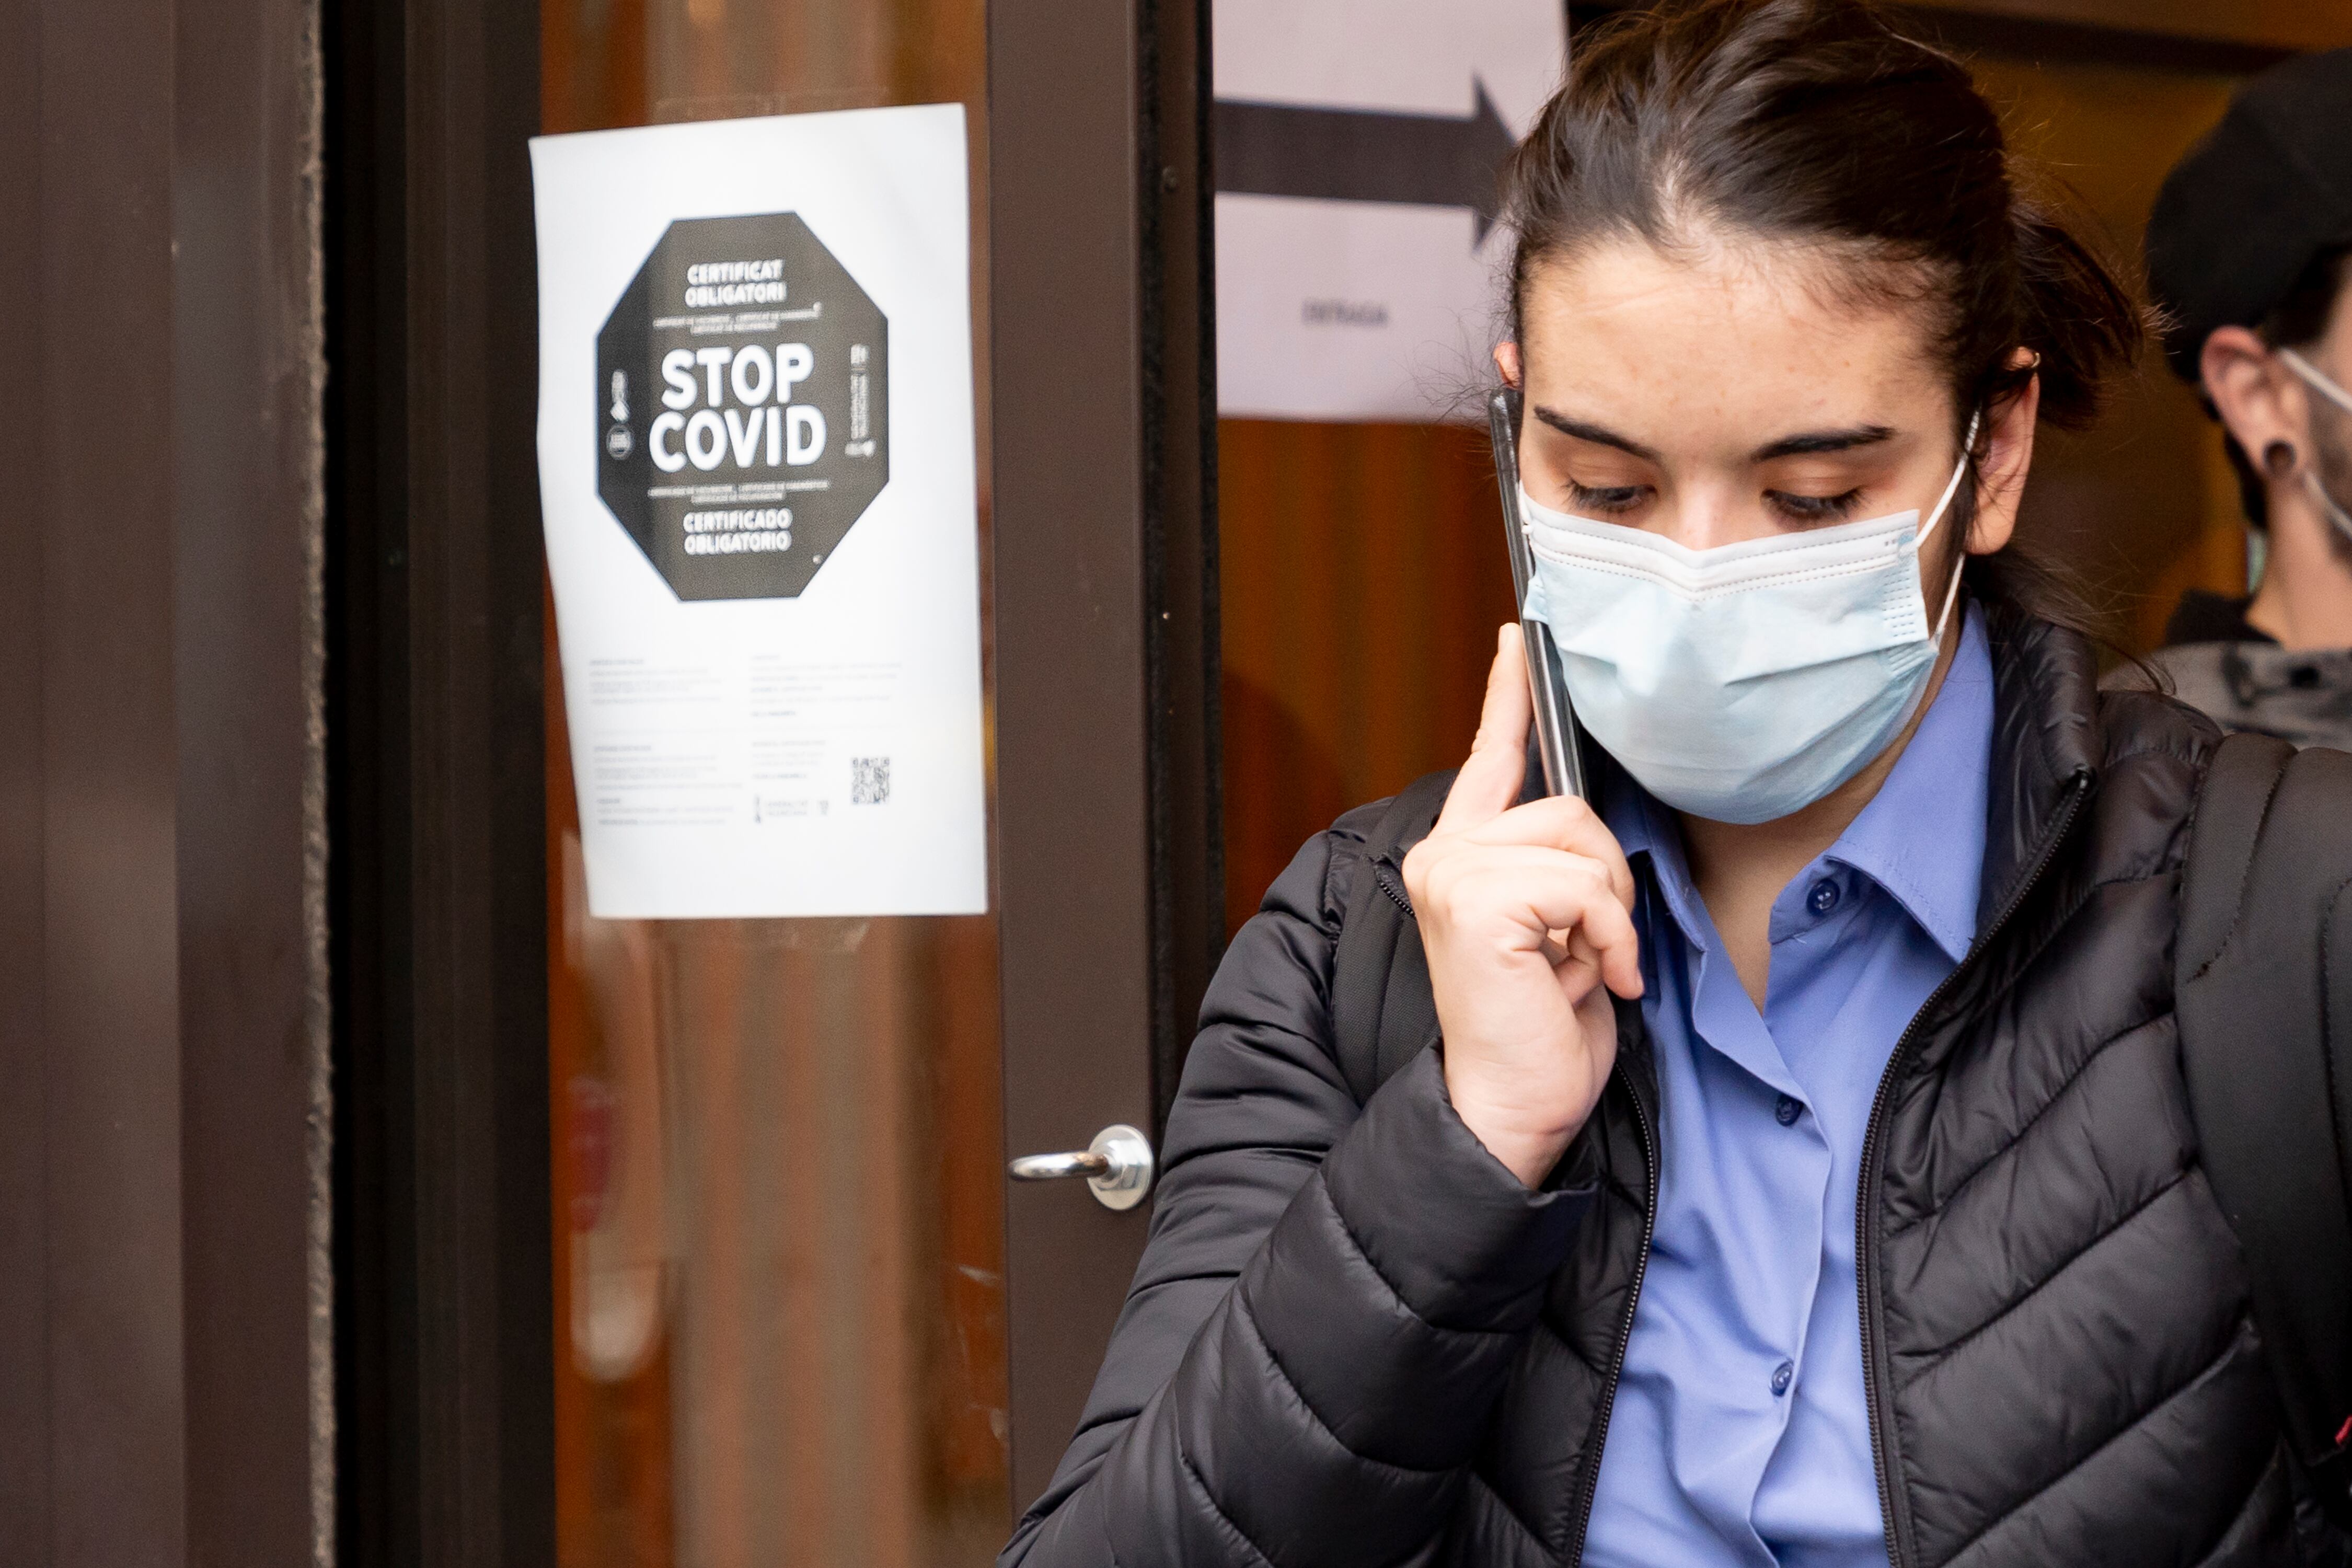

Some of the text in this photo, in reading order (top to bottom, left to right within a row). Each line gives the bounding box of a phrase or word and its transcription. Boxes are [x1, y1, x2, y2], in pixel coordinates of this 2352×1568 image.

[687, 259, 784, 285] CERTIFICAT
[685, 281, 787, 308] OBLIGATORI
[662, 343, 813, 410] STOP
[649, 405, 827, 472] COVID
[683, 508, 793, 533] CERTIFICADO
[684, 531, 792, 555] OBLIGATORIO
